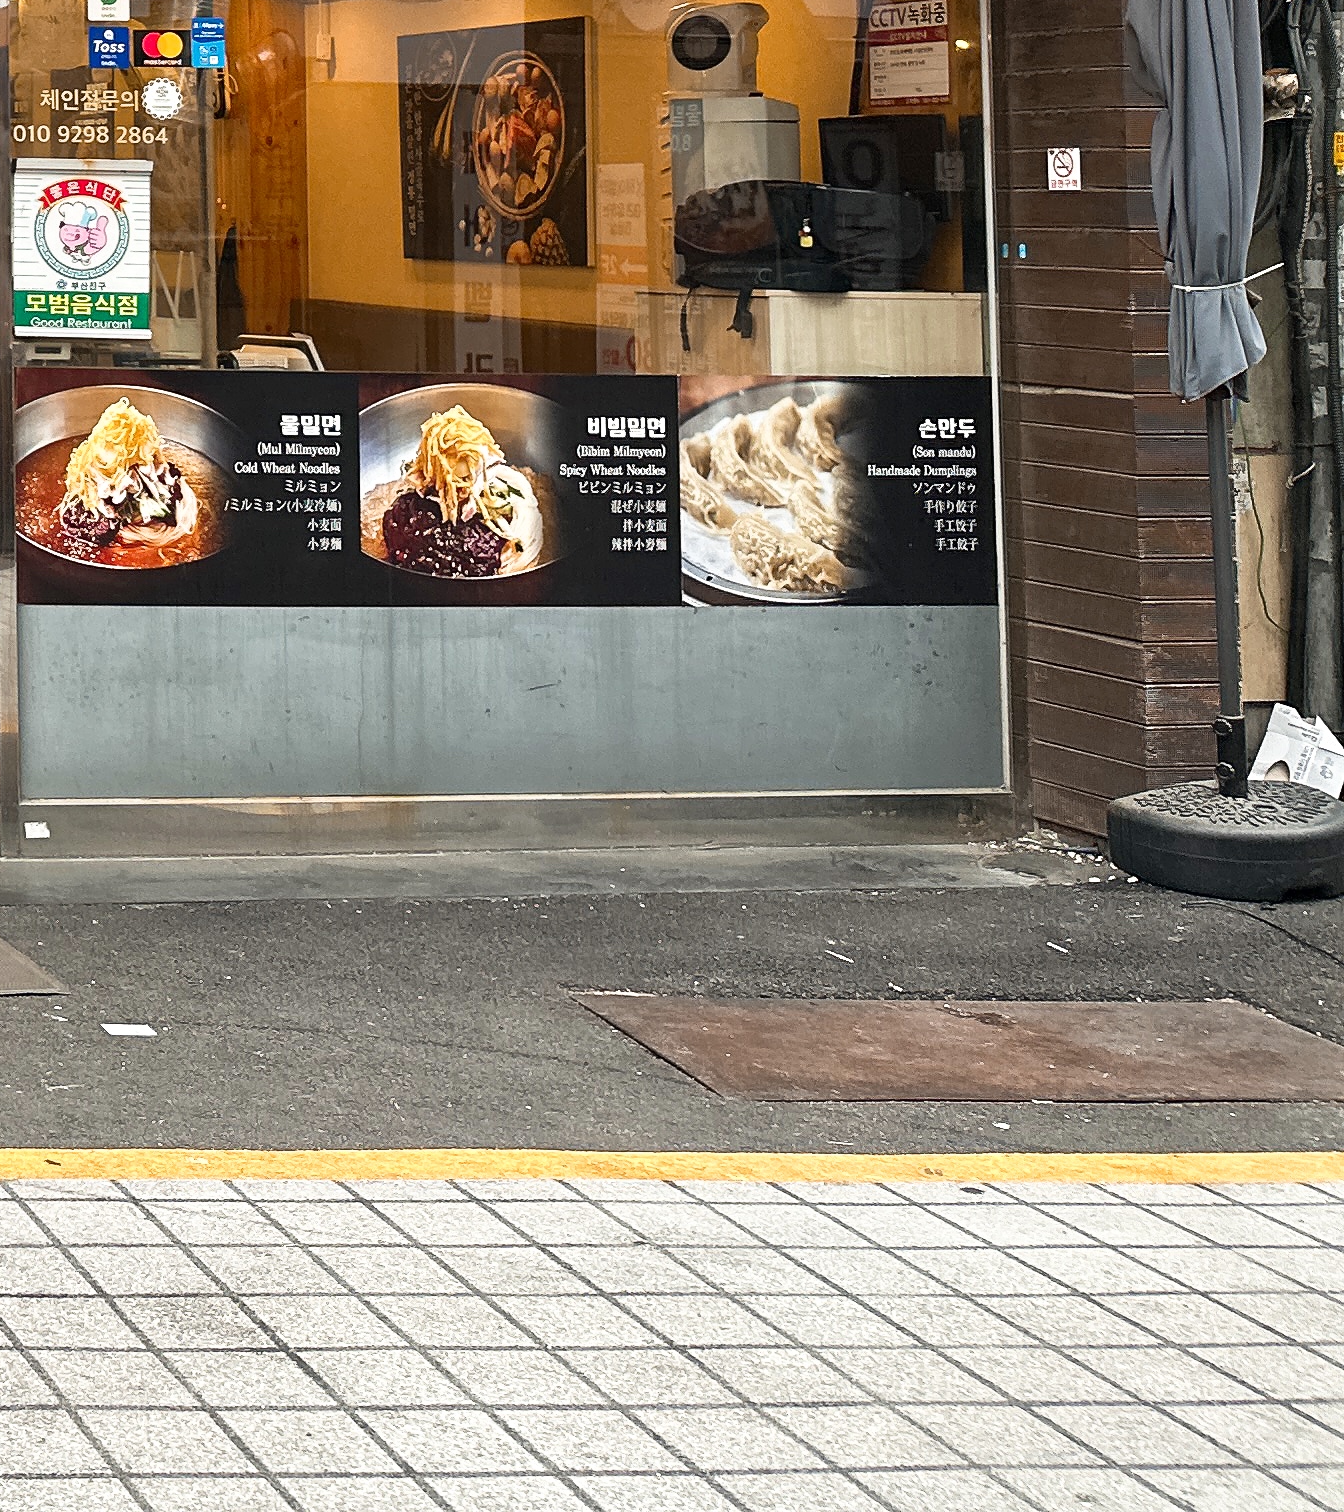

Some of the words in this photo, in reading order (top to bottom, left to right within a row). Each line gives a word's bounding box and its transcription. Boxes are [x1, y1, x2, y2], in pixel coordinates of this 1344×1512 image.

[92, 39, 126, 54] Toss
[143, 58, 183, 66] mastercard
[39, 88, 140, 112] 체인점문의
[13, 124, 51, 143] 010
[57, 124, 110, 144] 9298
[115, 125, 169, 145] 2864
[25, 293, 139, 317] 모범음식점
[29, 317, 64, 329] Good
[67, 317, 133, 330] Restaurant
[587, 416, 666, 438] 비빔밀면
[918, 418, 976, 439] 손만두
[257, 441, 282, 457] (Mul
[285, 441, 341, 457] Milmyeon)
[576, 444, 611, 459] (Bibim
[613, 444, 666, 459] Milmyeon)
[912, 444, 935, 459] (Son
[938, 444, 976, 459] mandu)
[234, 462, 258, 474] Cold
[261, 462, 296, 474] Wheat
[299, 462, 341, 474] Noodles
[559, 464, 587, 477] Spicy
[590, 464, 624, 476] Wheat
[626, 464, 666, 476] Noodles
[867, 464, 921, 477] Handmade
[923, 464, 977, 478] Dumplings
[284, 479, 342, 493] ミルミョン
[912, 482, 976, 495] ソンマンドゥ
